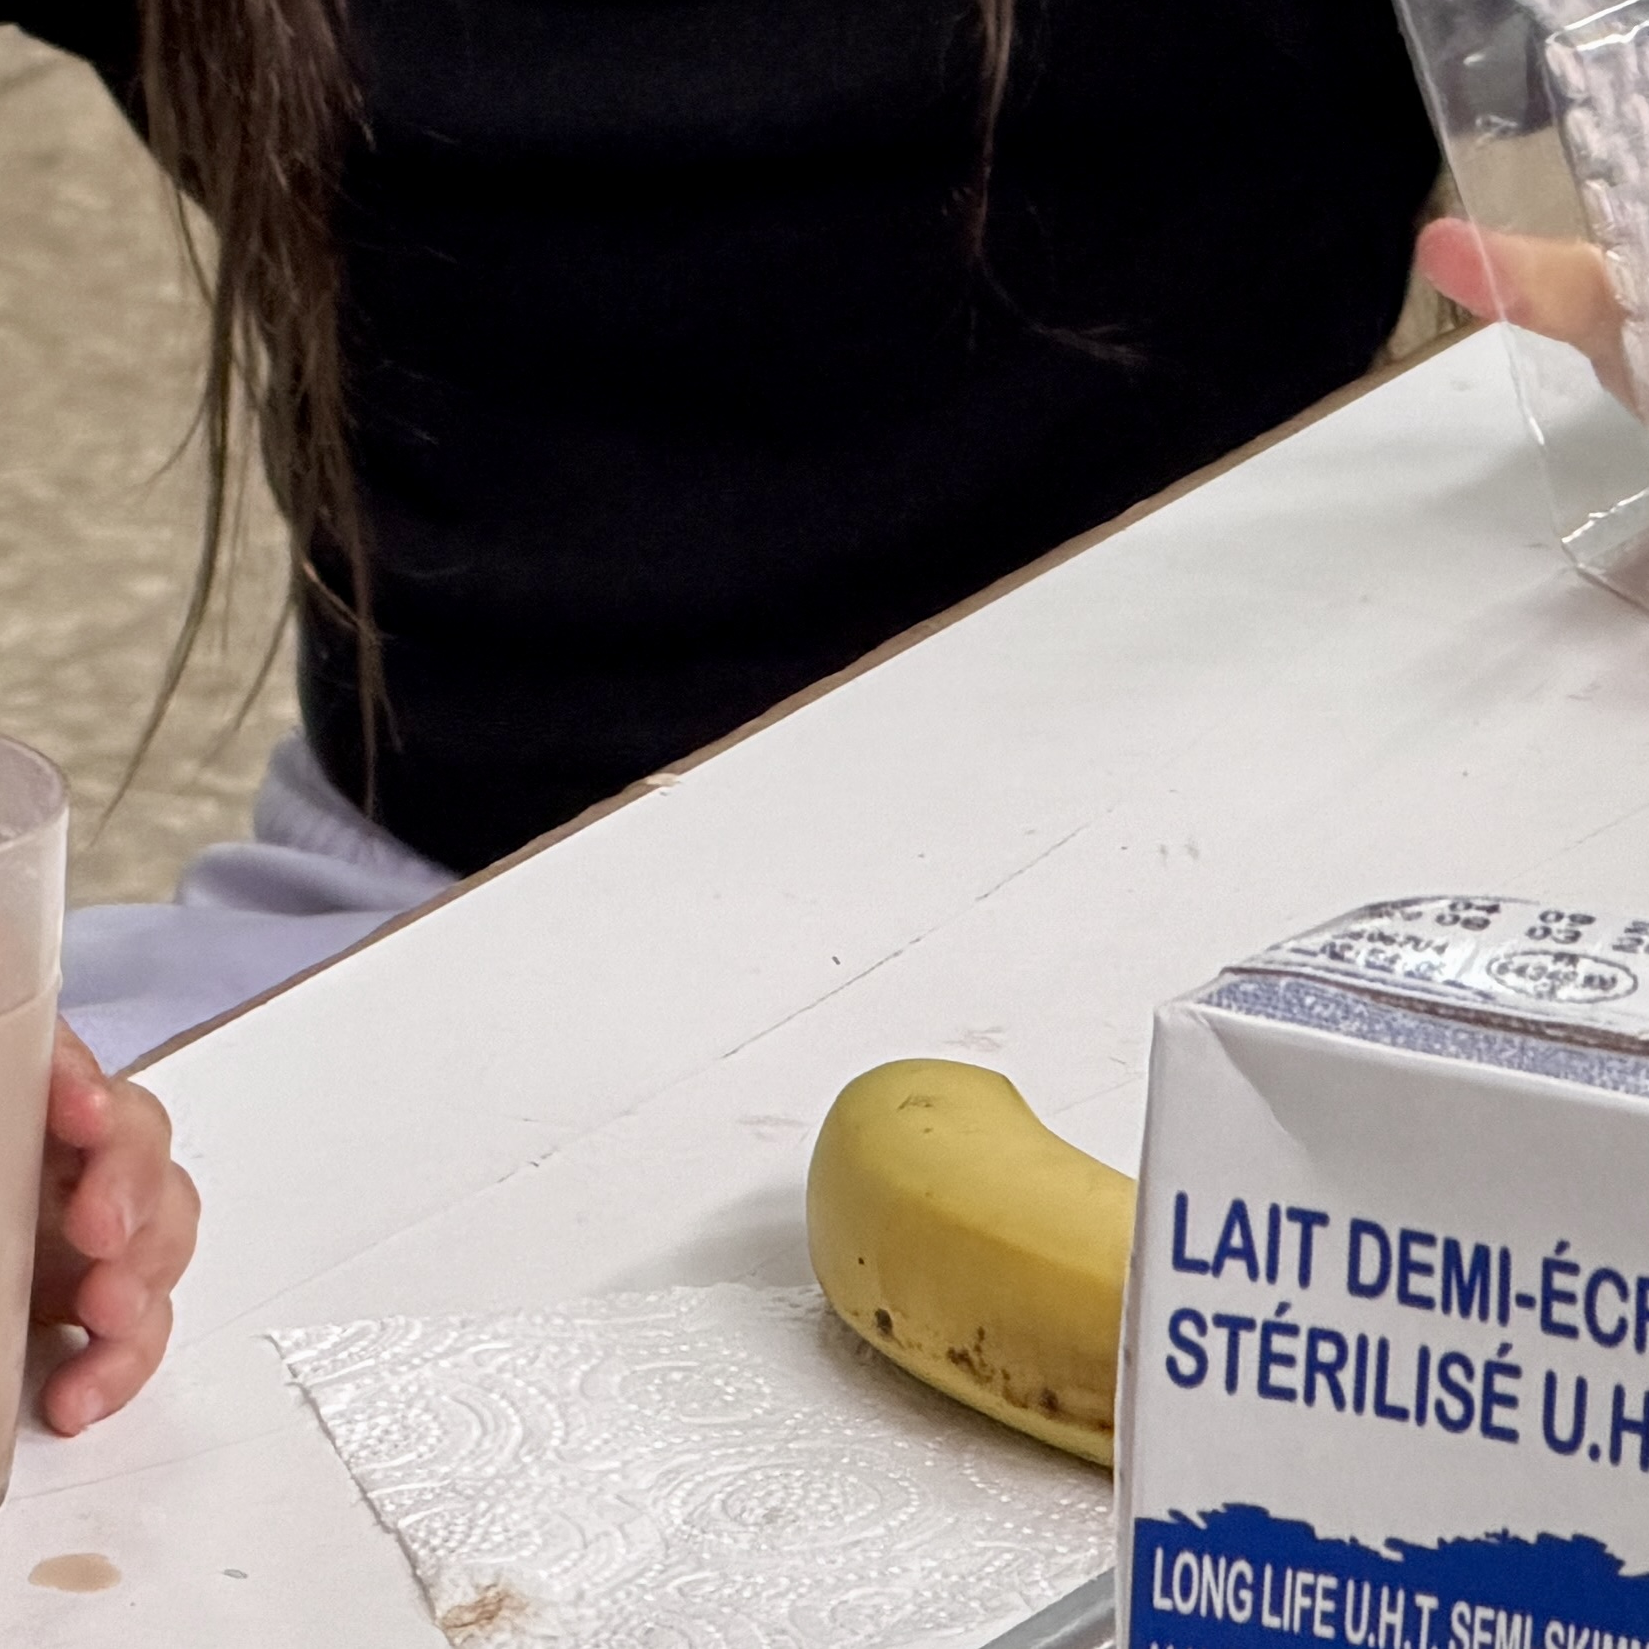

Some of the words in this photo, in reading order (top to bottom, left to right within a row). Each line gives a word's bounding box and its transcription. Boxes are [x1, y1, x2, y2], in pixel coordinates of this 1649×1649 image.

[1172, 1191, 1329, 1290] LAIT
[1166, 1302, 1522, 1442] STÉRILISÉ
[1153, 1547, 1251, 1622] LONG
[1262, 1564, 1336, 1639] LIFE
[1344, 1578, 1456, 1649] U.H.T.
